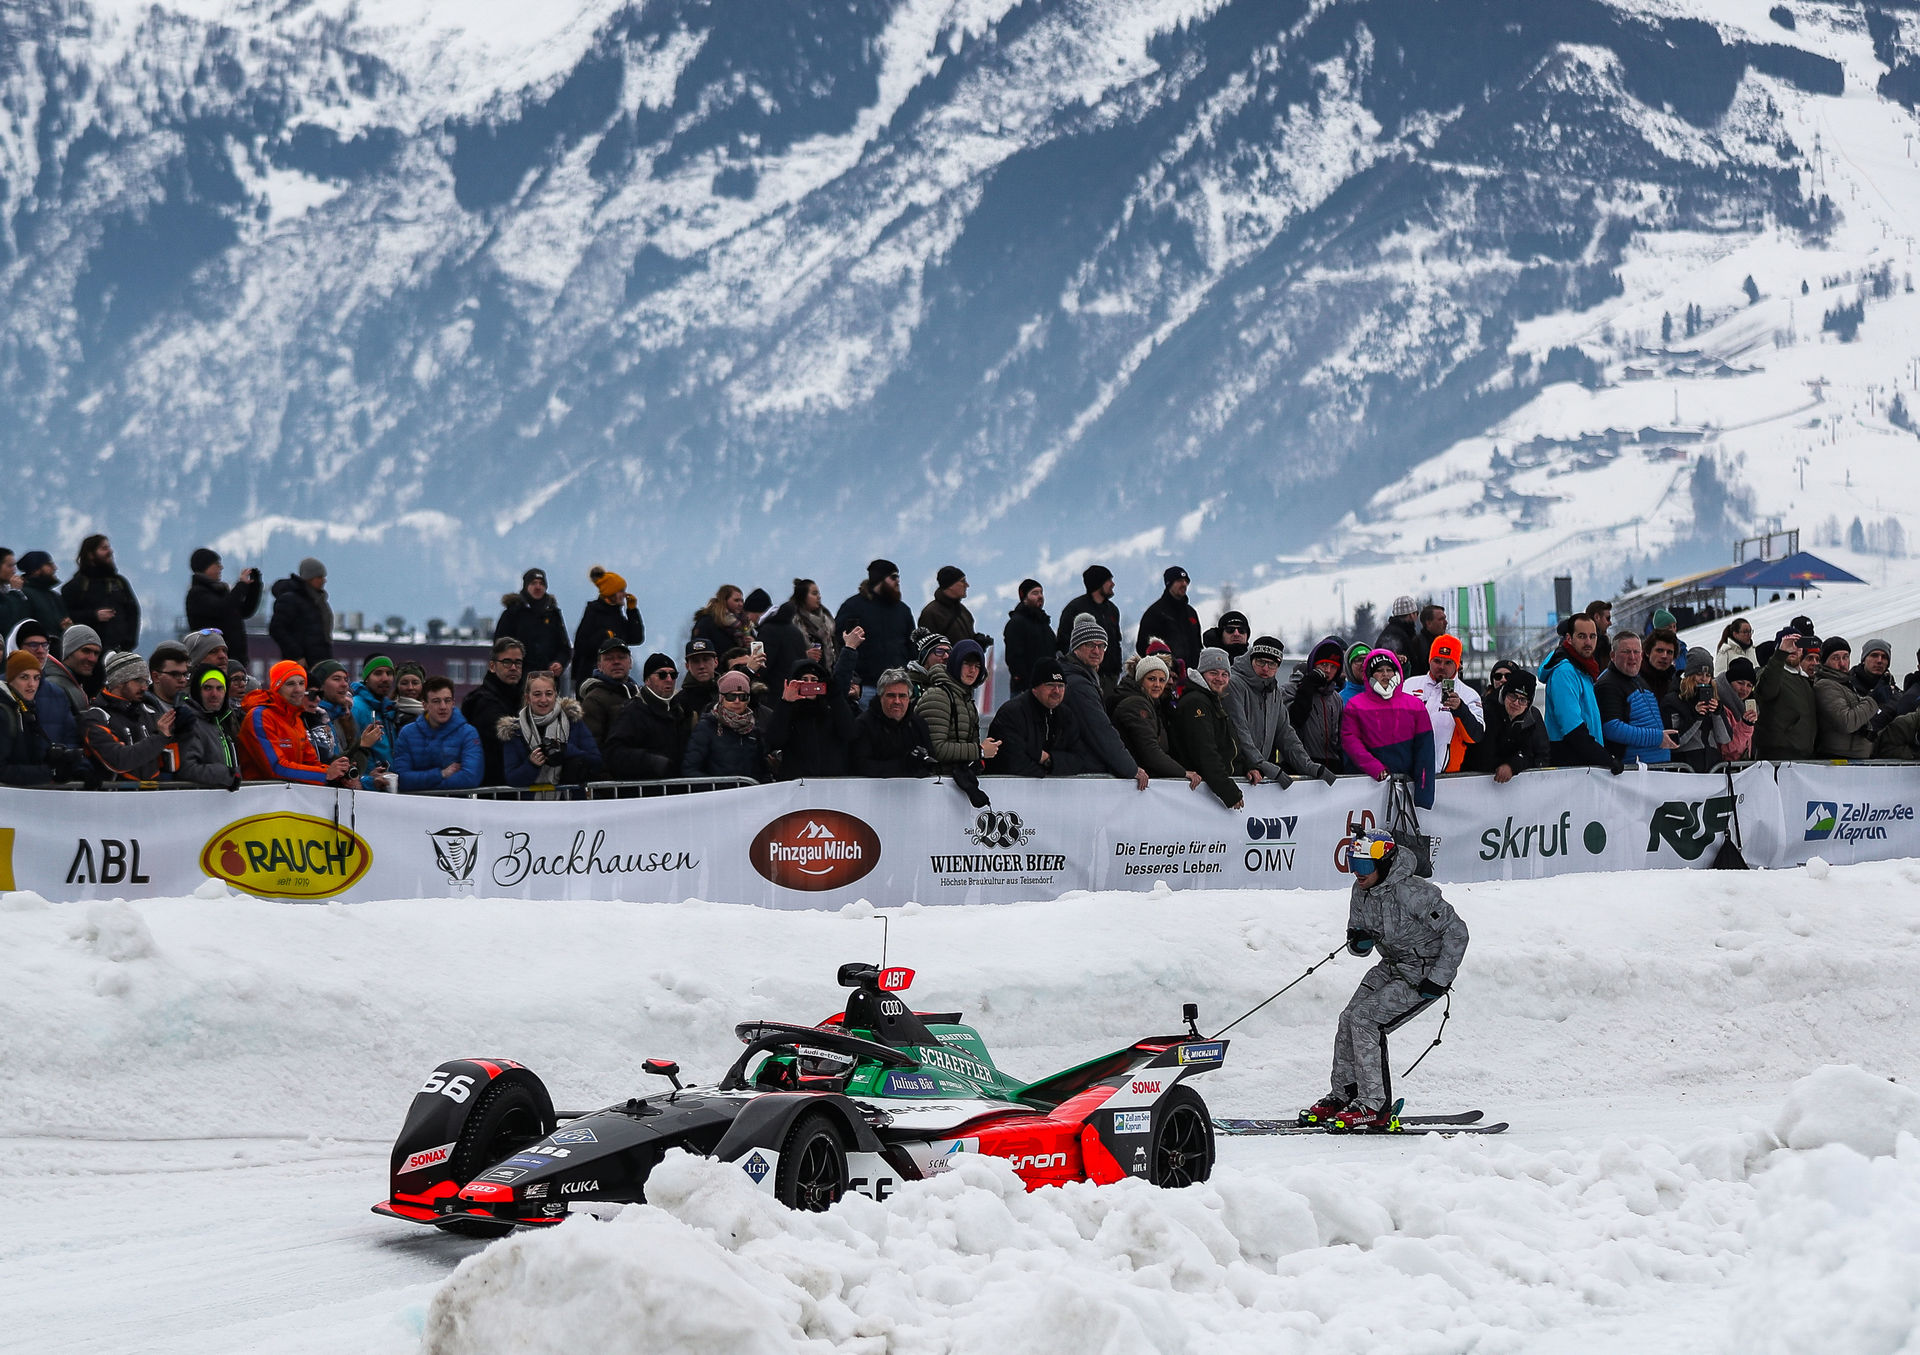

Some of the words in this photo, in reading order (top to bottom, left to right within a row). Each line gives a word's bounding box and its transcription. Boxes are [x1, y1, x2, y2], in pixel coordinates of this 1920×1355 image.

[1840, 802, 1870, 821] Zell
[1887, 803, 1914, 820] See
[1479, 811, 1571, 861] skruf
[1833, 823, 1888, 846] Kaprun
[245, 838, 347, 876] RAUCH
[492, 829, 700, 887] Backhausen
[769, 842, 822, 865] Pinzgau
[824, 841, 862, 860] Milch
[1115, 842, 1136, 856] Die
[1138, 841, 1186, 858] Energie
[1188, 840, 1206, 854] für
[1208, 840, 1227, 853] ein
[66, 838, 151, 884] ABL
[930, 854, 1024, 874] WIENINGER
[1025, 854, 1066, 872] BIER
[1124, 862, 1179, 876] besseres
[1182, 861, 1223, 874] Leben.
[1244, 848, 1295, 872] OMV
[940, 877, 967, 887] Höchste
[968, 876, 1005, 886] Braukultur
[1020, 875, 1055, 885] Teisendorf.
[885, 971, 906, 988] ABT
[803, 1048, 819, 1057] Audi
[820, 1050, 843, 1061] e-tron
[1190, 1049, 1219, 1059] MICHELIN
[919, 1046, 994, 1084] SCHAEFFLER
[419, 1071, 476, 1104] 66
[891, 1075, 919, 1091] Julius
[918, 1076, 935, 1090] Bär
[1132, 1081, 1161, 1094] SONAX
[410, 1148, 447, 1168] SONAX
[1008, 1152, 1067, 1170] tron
[748, 1163, 768, 1174] LGT
[560, 1179, 600, 1195] KUKA
